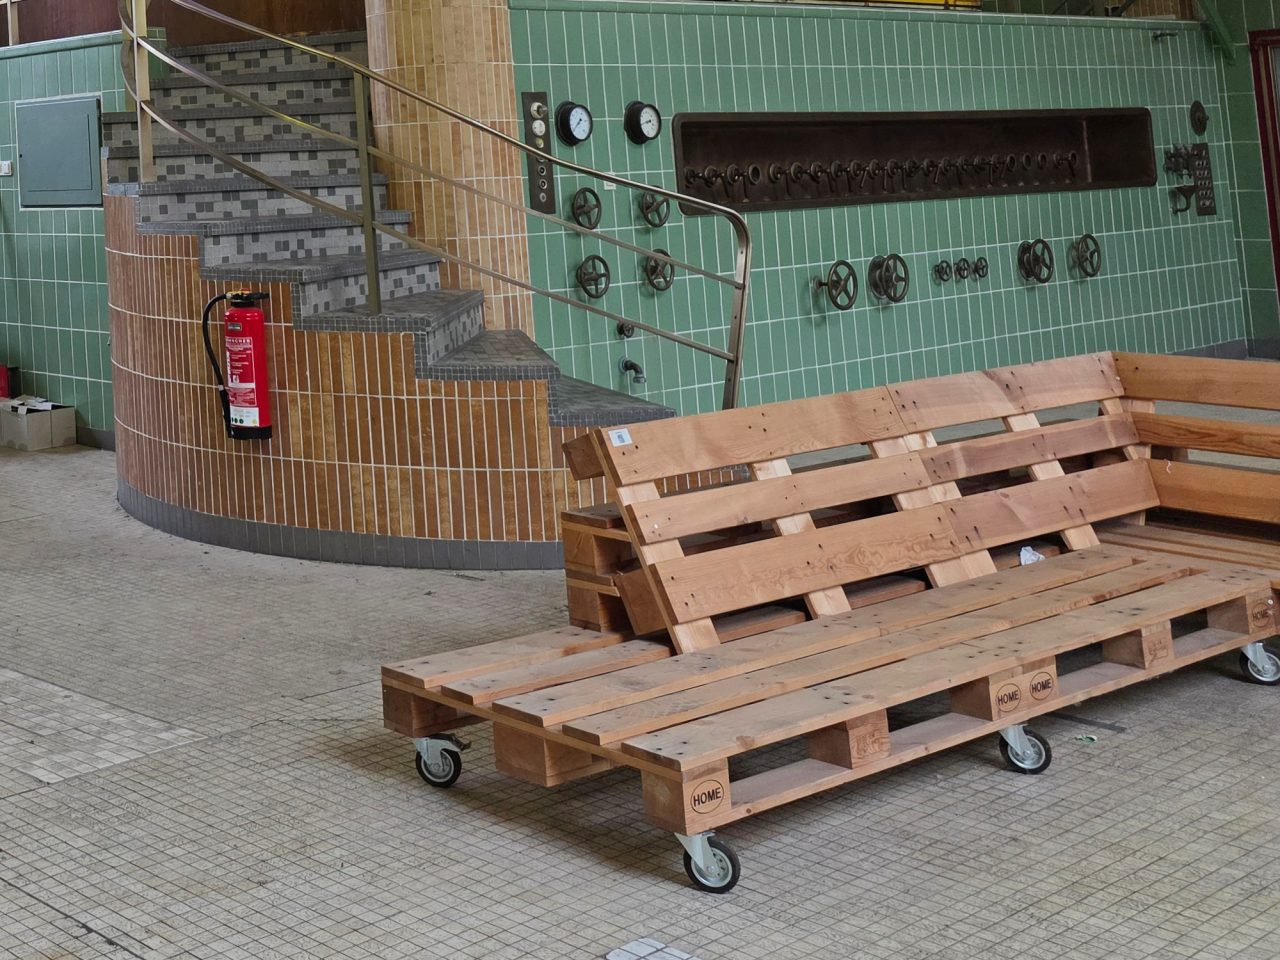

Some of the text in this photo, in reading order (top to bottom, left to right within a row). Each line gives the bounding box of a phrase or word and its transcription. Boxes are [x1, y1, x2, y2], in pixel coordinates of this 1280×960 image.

[1031, 678, 1052, 694] HOME
[997, 689, 1020, 706] HOME
[693, 786, 722, 808] HOME
